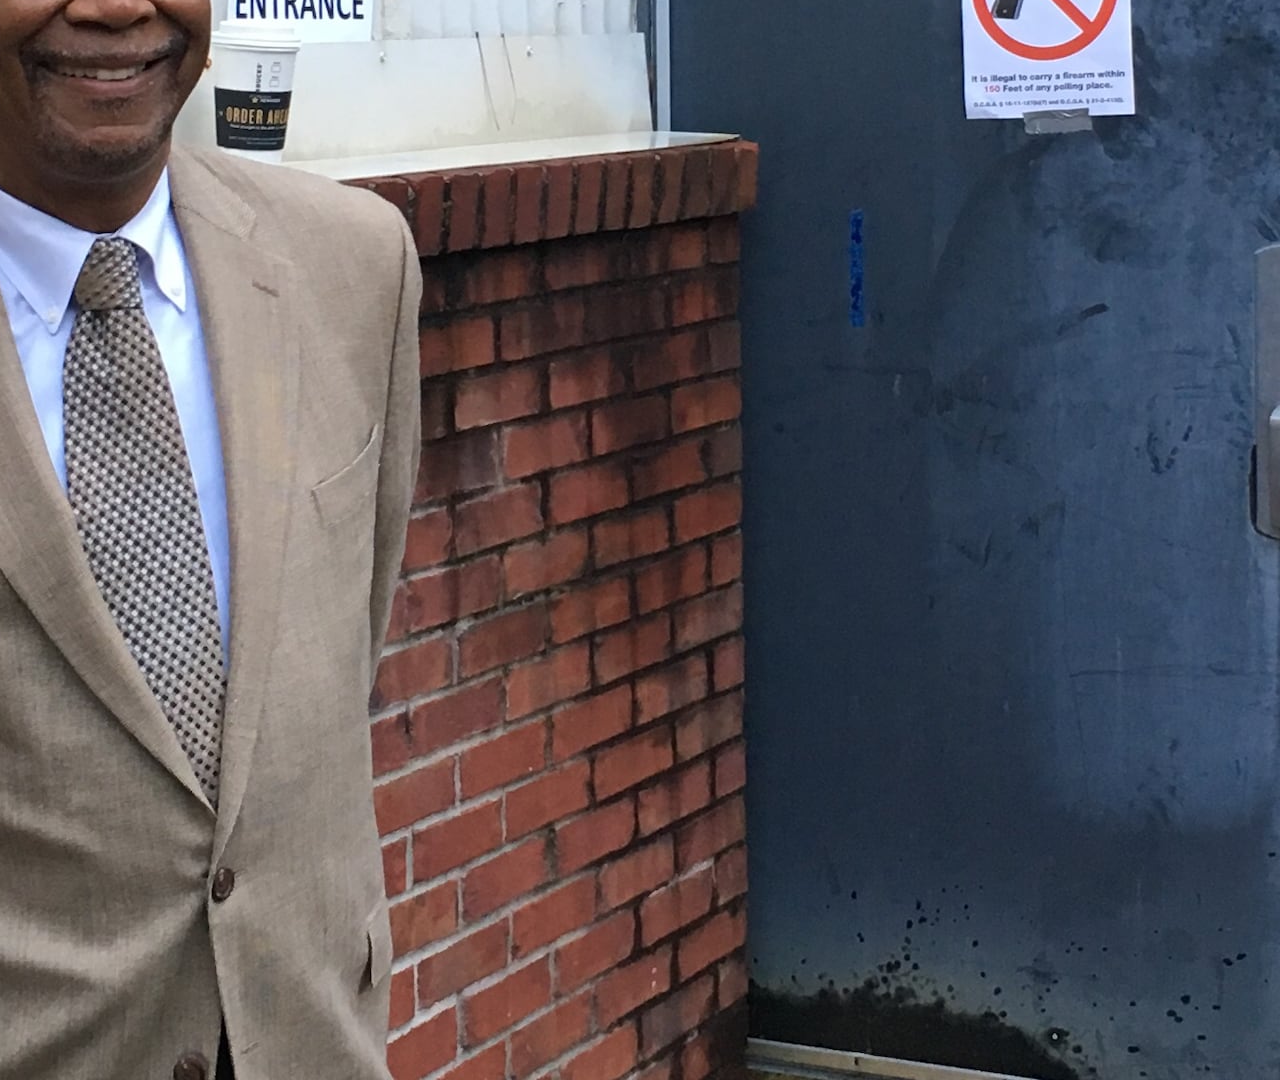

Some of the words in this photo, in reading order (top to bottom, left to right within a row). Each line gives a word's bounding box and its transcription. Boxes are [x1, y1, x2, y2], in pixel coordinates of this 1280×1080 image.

[971, 75, 978, 83] It
[990, 74, 1016, 83] illegal
[1029, 74, 1052, 82] carry
[1063, 71, 1095, 79] firearm
[1097, 70, 1125, 78] within
[984, 85, 1001, 93] 150
[1002, 84, 1022, 93] Feet
[1024, 84, 1034, 92] of
[1035, 84, 1051, 92] any
[1053, 82, 1084, 92] polling
[1086, 82, 1113, 91] place.
[225, 106, 263, 125] ORDER
